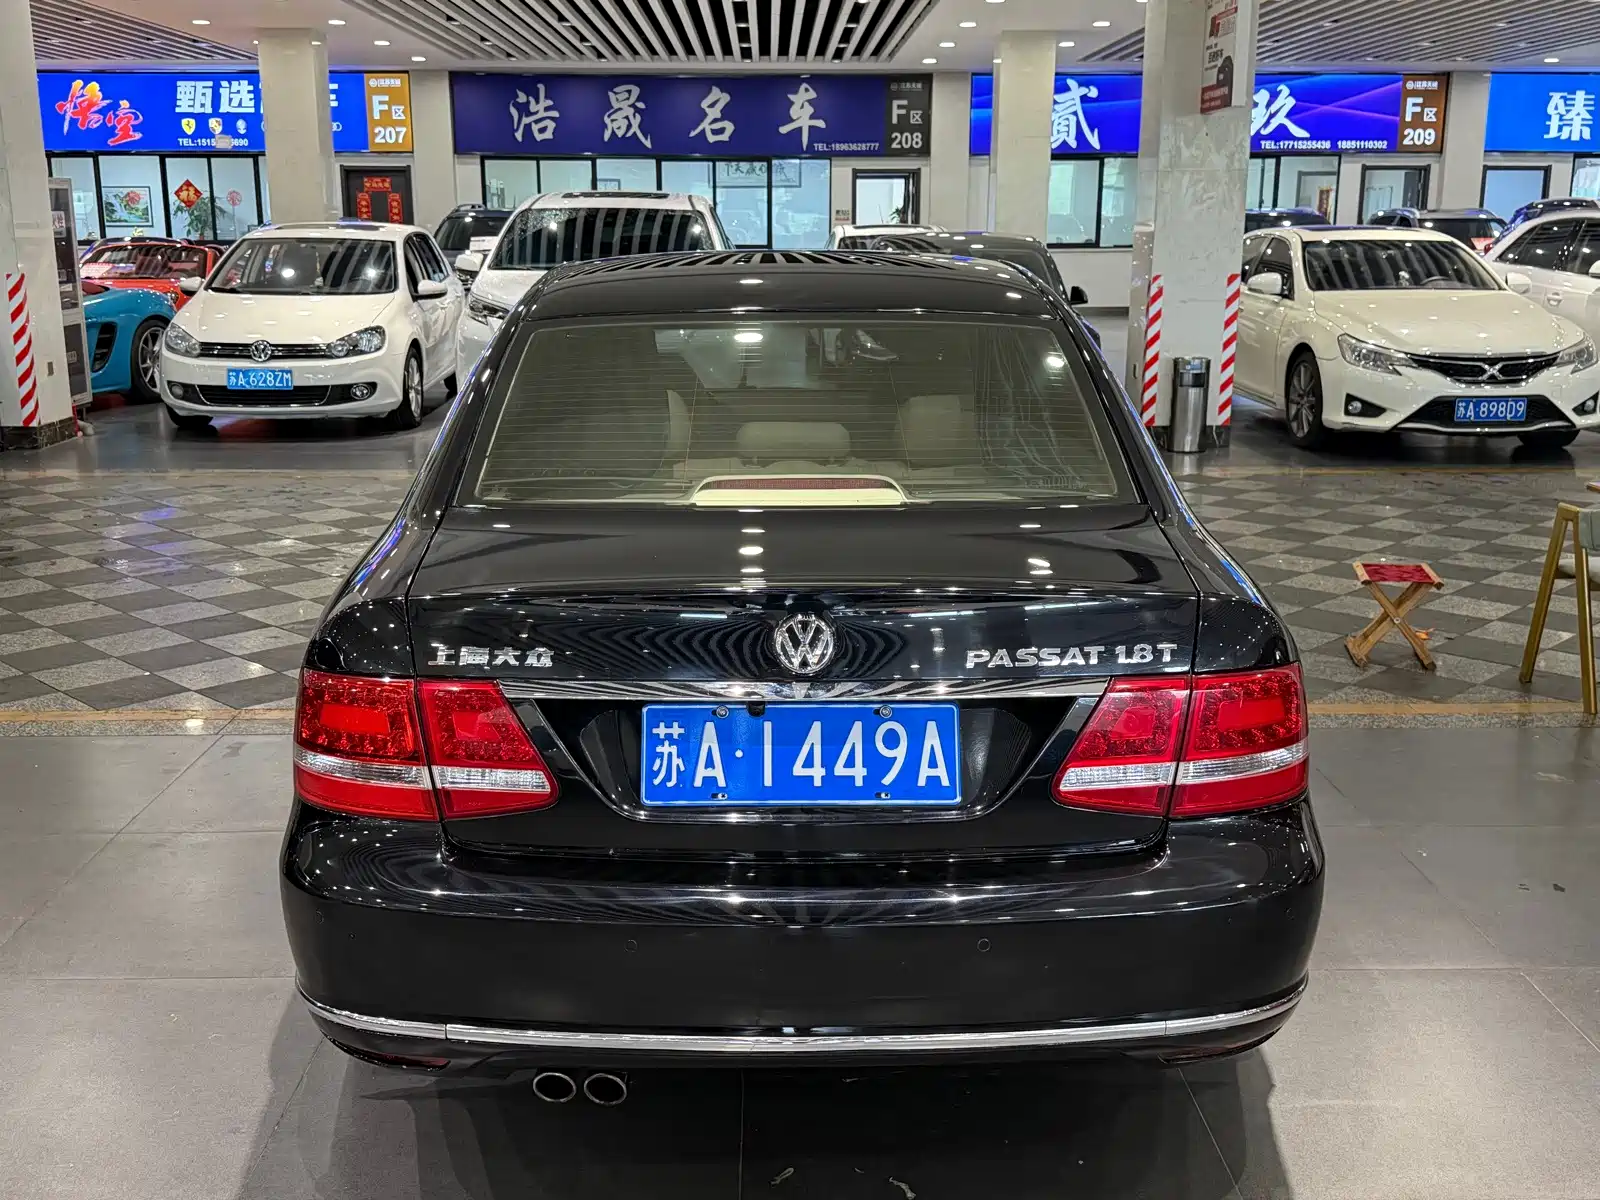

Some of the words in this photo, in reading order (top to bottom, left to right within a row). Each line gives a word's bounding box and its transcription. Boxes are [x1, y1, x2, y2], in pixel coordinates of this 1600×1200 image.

[372, 95, 406, 120] F区
[509, 82, 826, 152] 浩晟名车
[891, 99, 923, 124] F区
[1405, 97, 1437, 122] F区
[1543, 90, 1595, 141] 臻
[374, 126, 407, 144] 207
[891, 132, 923, 149] 208
[1403, 128, 1436, 146] 209
[965, 645, 1105, 669] PASSAT
